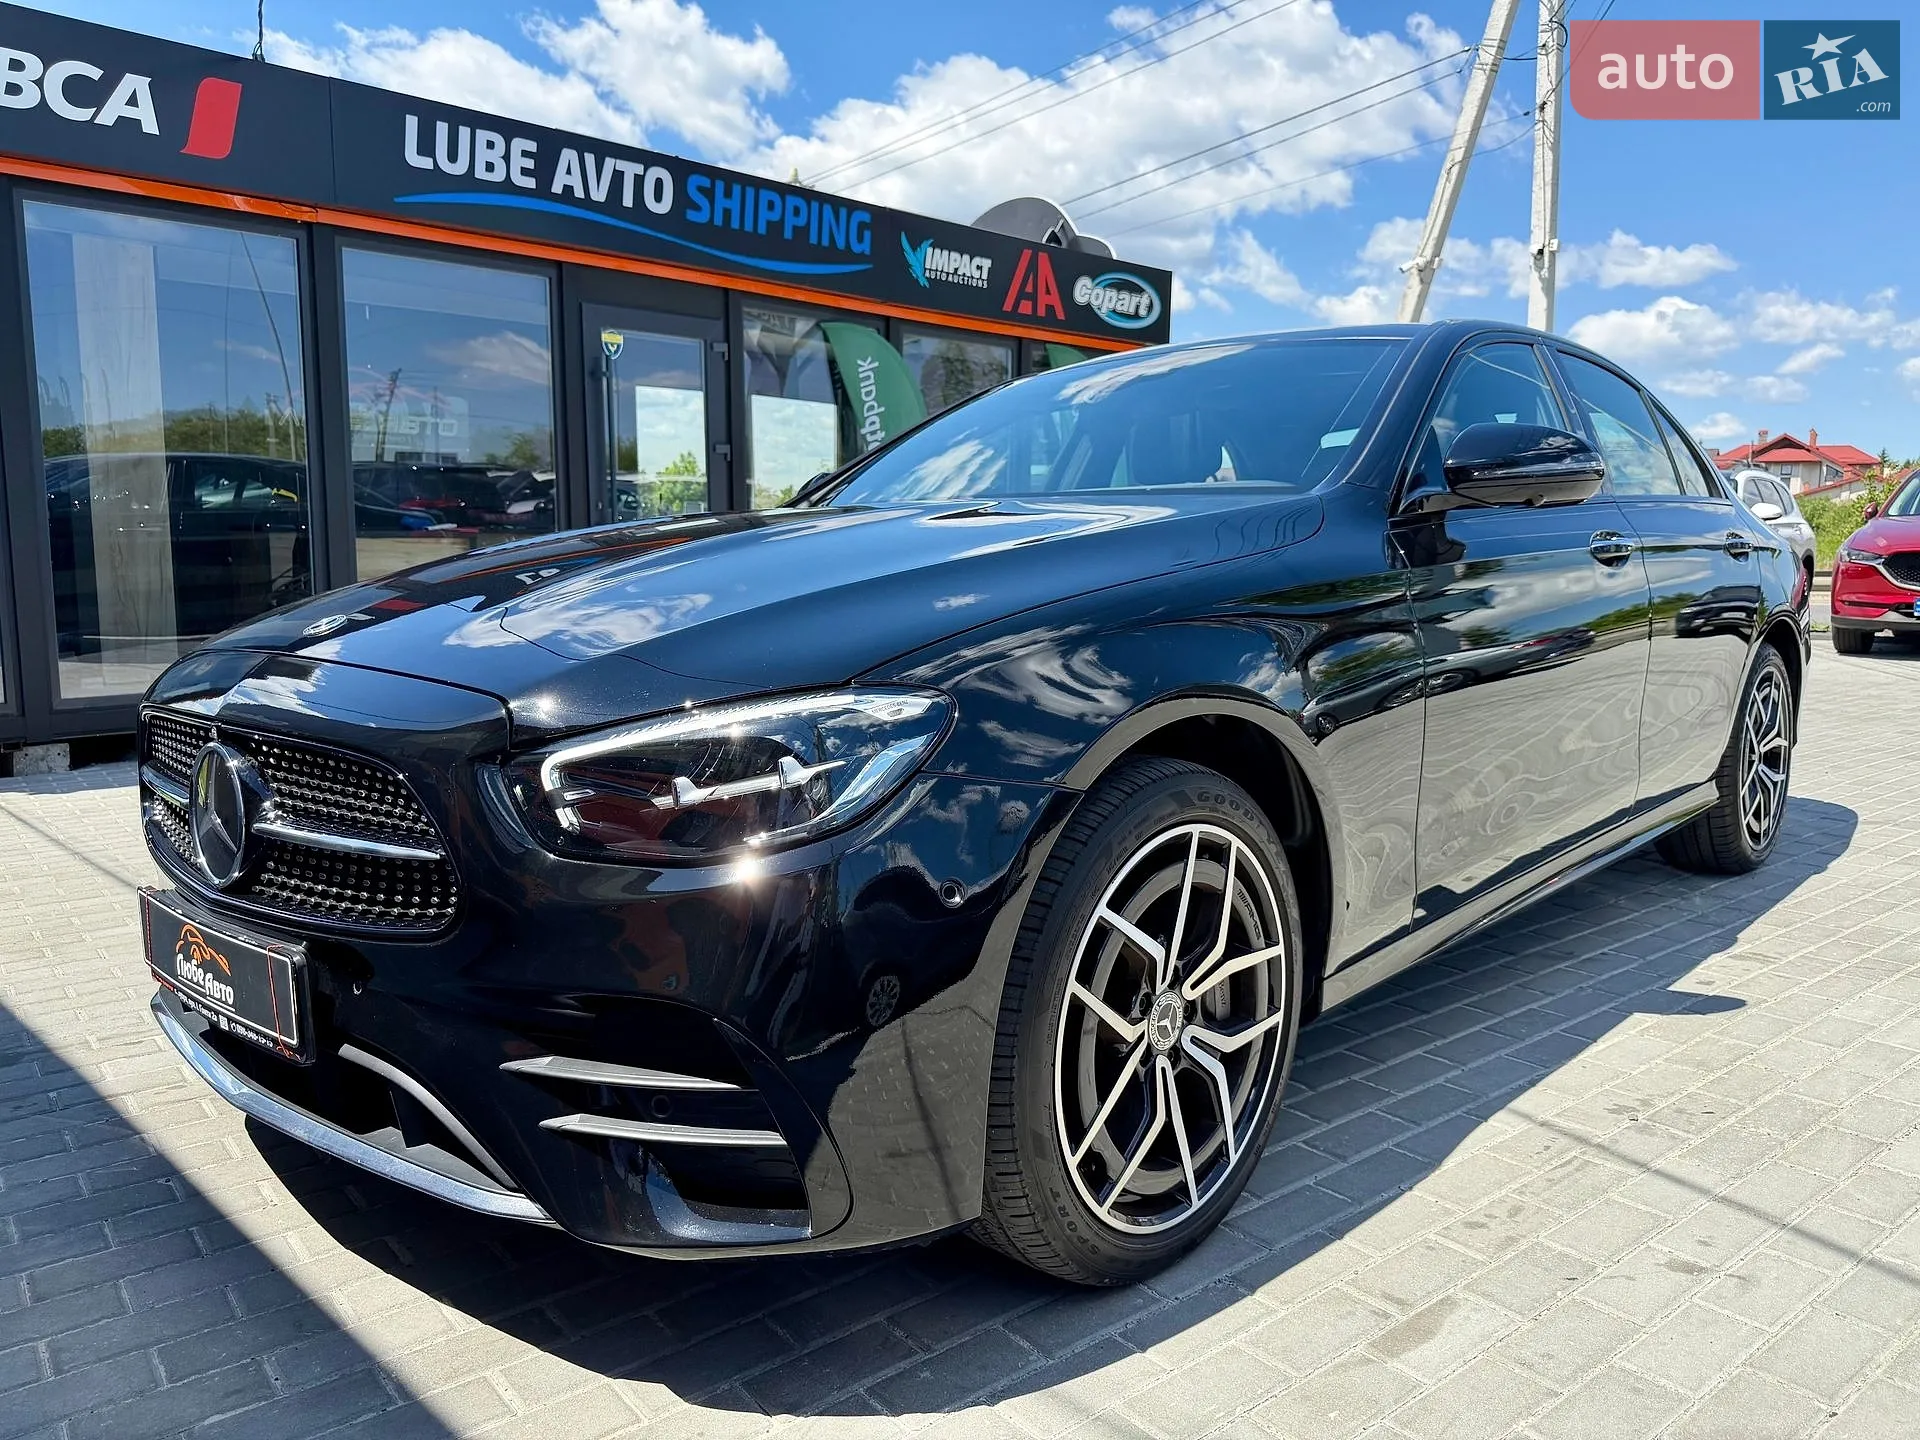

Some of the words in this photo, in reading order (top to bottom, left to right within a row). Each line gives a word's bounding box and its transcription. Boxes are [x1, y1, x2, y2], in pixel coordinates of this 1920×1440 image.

[0, 47, 160, 136] BCA
[404, 114, 538, 190] LUBE
[551, 147, 674, 216] AVTO
[686, 174, 872, 257] SHIPPING
[925, 246, 992, 280] IMPACT
[1073, 275, 1152, 318] Copart
[1050, 1187, 1101, 1256] SPORT
